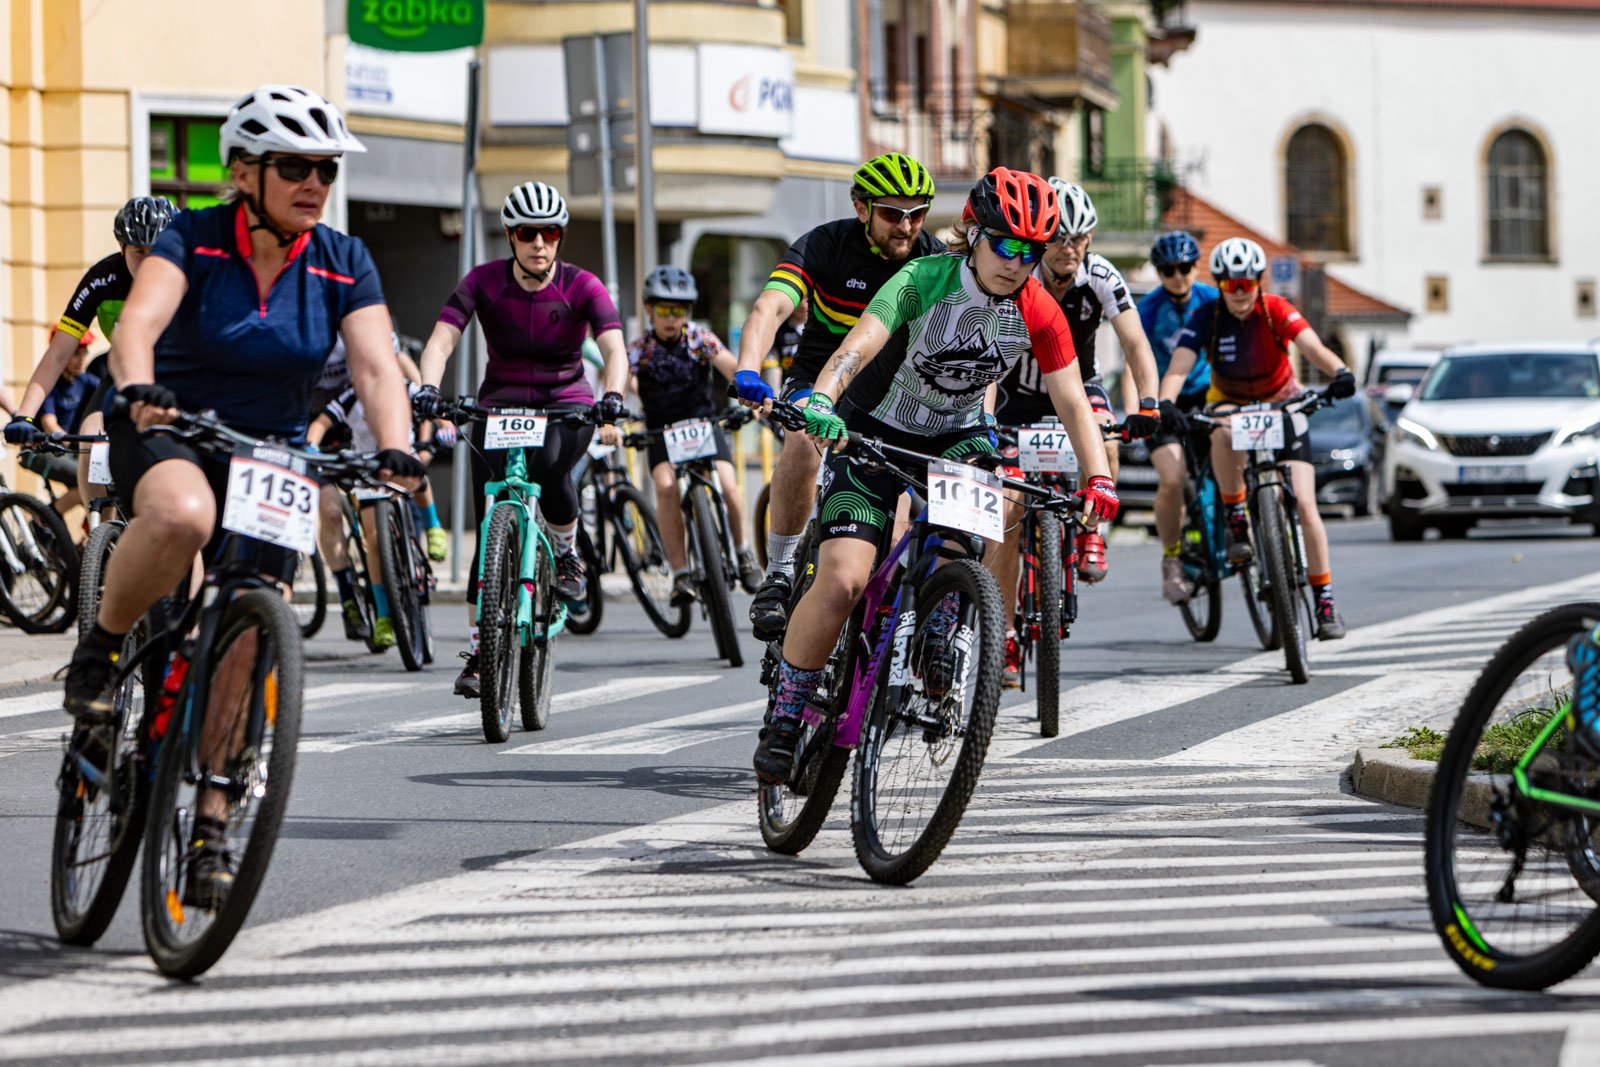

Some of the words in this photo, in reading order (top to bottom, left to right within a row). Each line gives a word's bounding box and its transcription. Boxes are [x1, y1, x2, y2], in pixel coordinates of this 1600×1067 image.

[846, 278, 867, 290] dhb
[498, 418, 536, 431] 160
[1029, 433, 1067, 449] 447
[240, 468, 311, 514] 1153
[934, 479, 998, 515] 1012
[829, 523, 858, 534] quest
